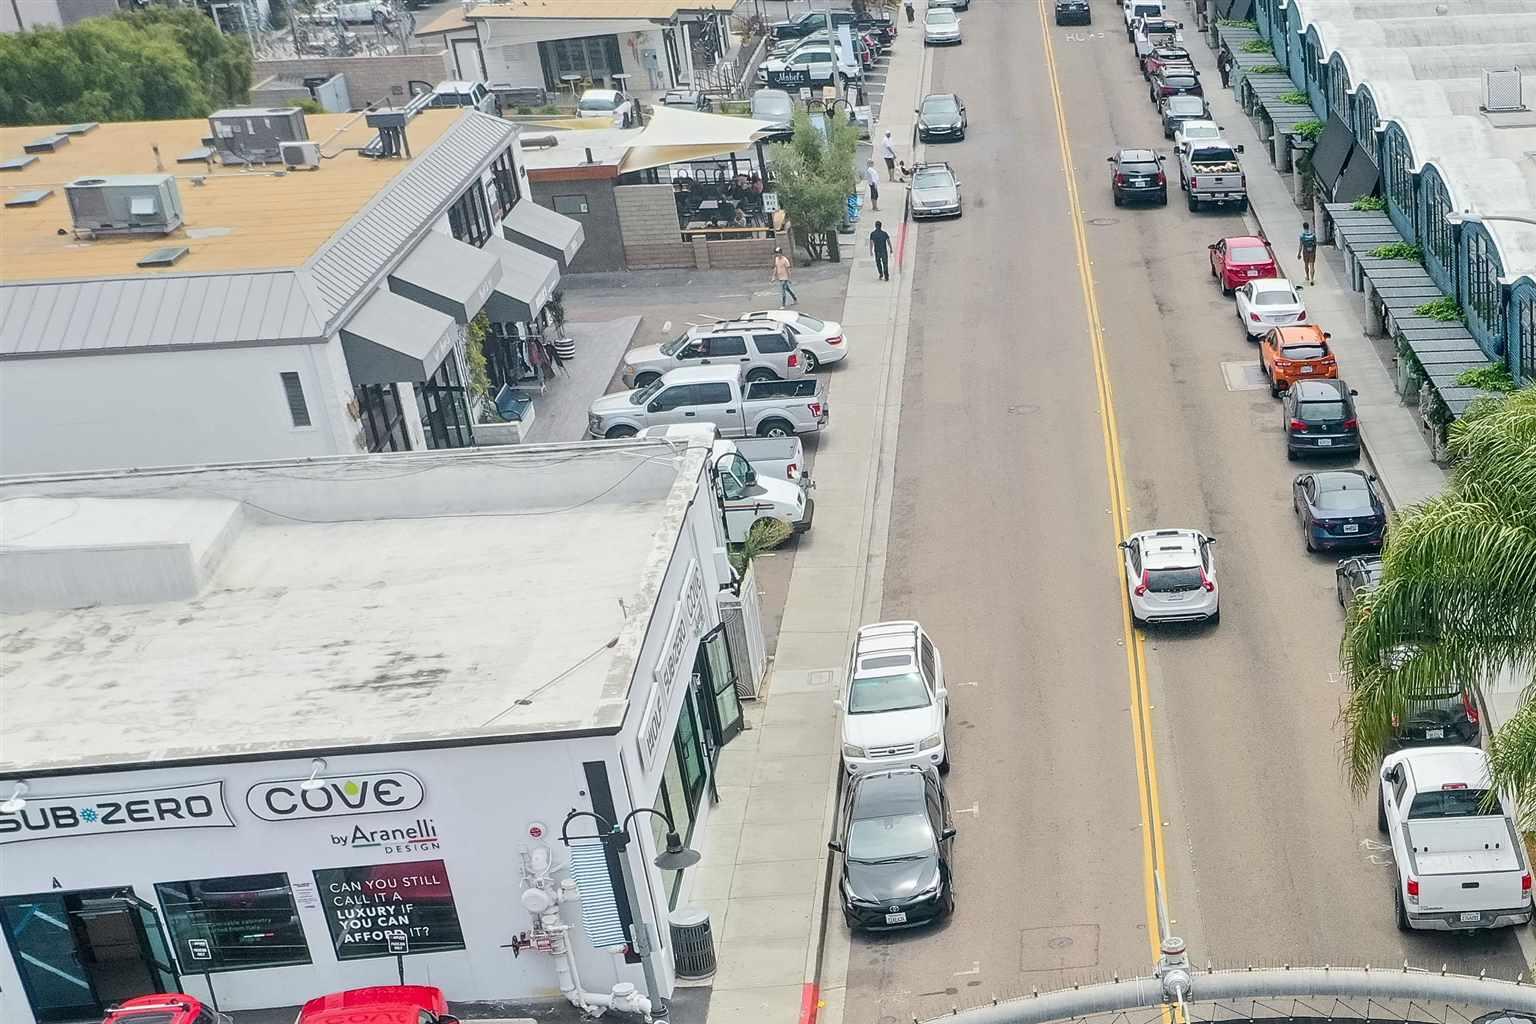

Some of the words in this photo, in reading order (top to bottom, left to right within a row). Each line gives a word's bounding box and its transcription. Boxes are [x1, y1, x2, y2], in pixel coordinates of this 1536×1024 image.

[265, 779, 405, 815] COVE
[96, 795, 213, 824] ZERO
[331, 834, 348, 846] by
[351, 819, 437, 844] Aranelli
[385, 842, 440, 854] DESIGN
[329, 881, 361, 893] CAN
[365, 878, 397, 890] YOU
[402, 875, 441, 887] STILL
[333, 895, 370, 907] CALL
[374, 893, 387, 903] IT
[392, 892, 402, 901] A
[337, 905, 395, 919] LUXURY
[401, 904, 414, 913] IF
[339, 918, 372, 930] YOU
[378, 915, 410, 927] CAN
[409, 926, 431, 937] IT?
